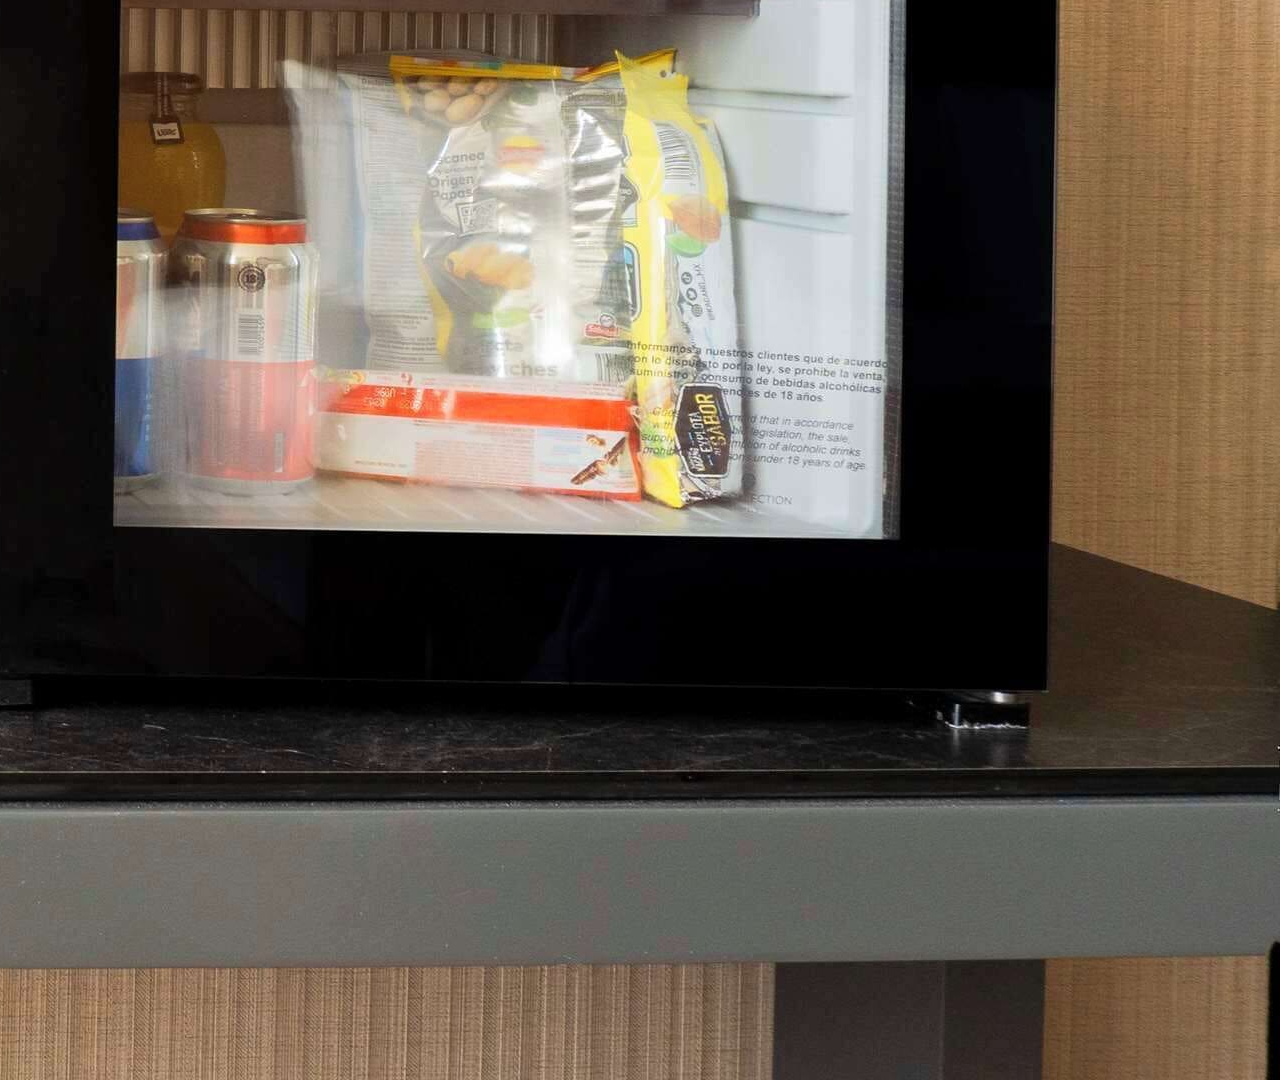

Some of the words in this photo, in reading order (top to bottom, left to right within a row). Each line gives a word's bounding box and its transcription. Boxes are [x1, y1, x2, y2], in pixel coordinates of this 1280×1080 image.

[427, 175, 474, 190] Origen
[626, 341, 692, 354] Informamos
[706, 348, 754, 359] nuestros
[757, 351, 800, 362] clientes
[803, 355, 824, 364] que
[827, 355, 841, 364] de
[843, 358, 889, 369] acuerdo
[723, 362, 741, 372] por
[778, 366, 792, 375] se
[840, 368, 850, 378] la
[756, 376, 770, 385] de
[773, 377, 816, 390] bebidas
[763, 389, 777, 399] de
[760, 415, 779, 424] that
[793, 419, 855, 430] accordance
[807, 431, 824, 441] the
[768, 441, 781, 451] of
[782, 442, 827, 454] alcoholic
[829, 446, 862, 457] drinks
[753, 455, 784, 465] under
[787, 455, 801, 465] 18
[801, 458, 831, 468] years
[833, 459, 846, 468] of
